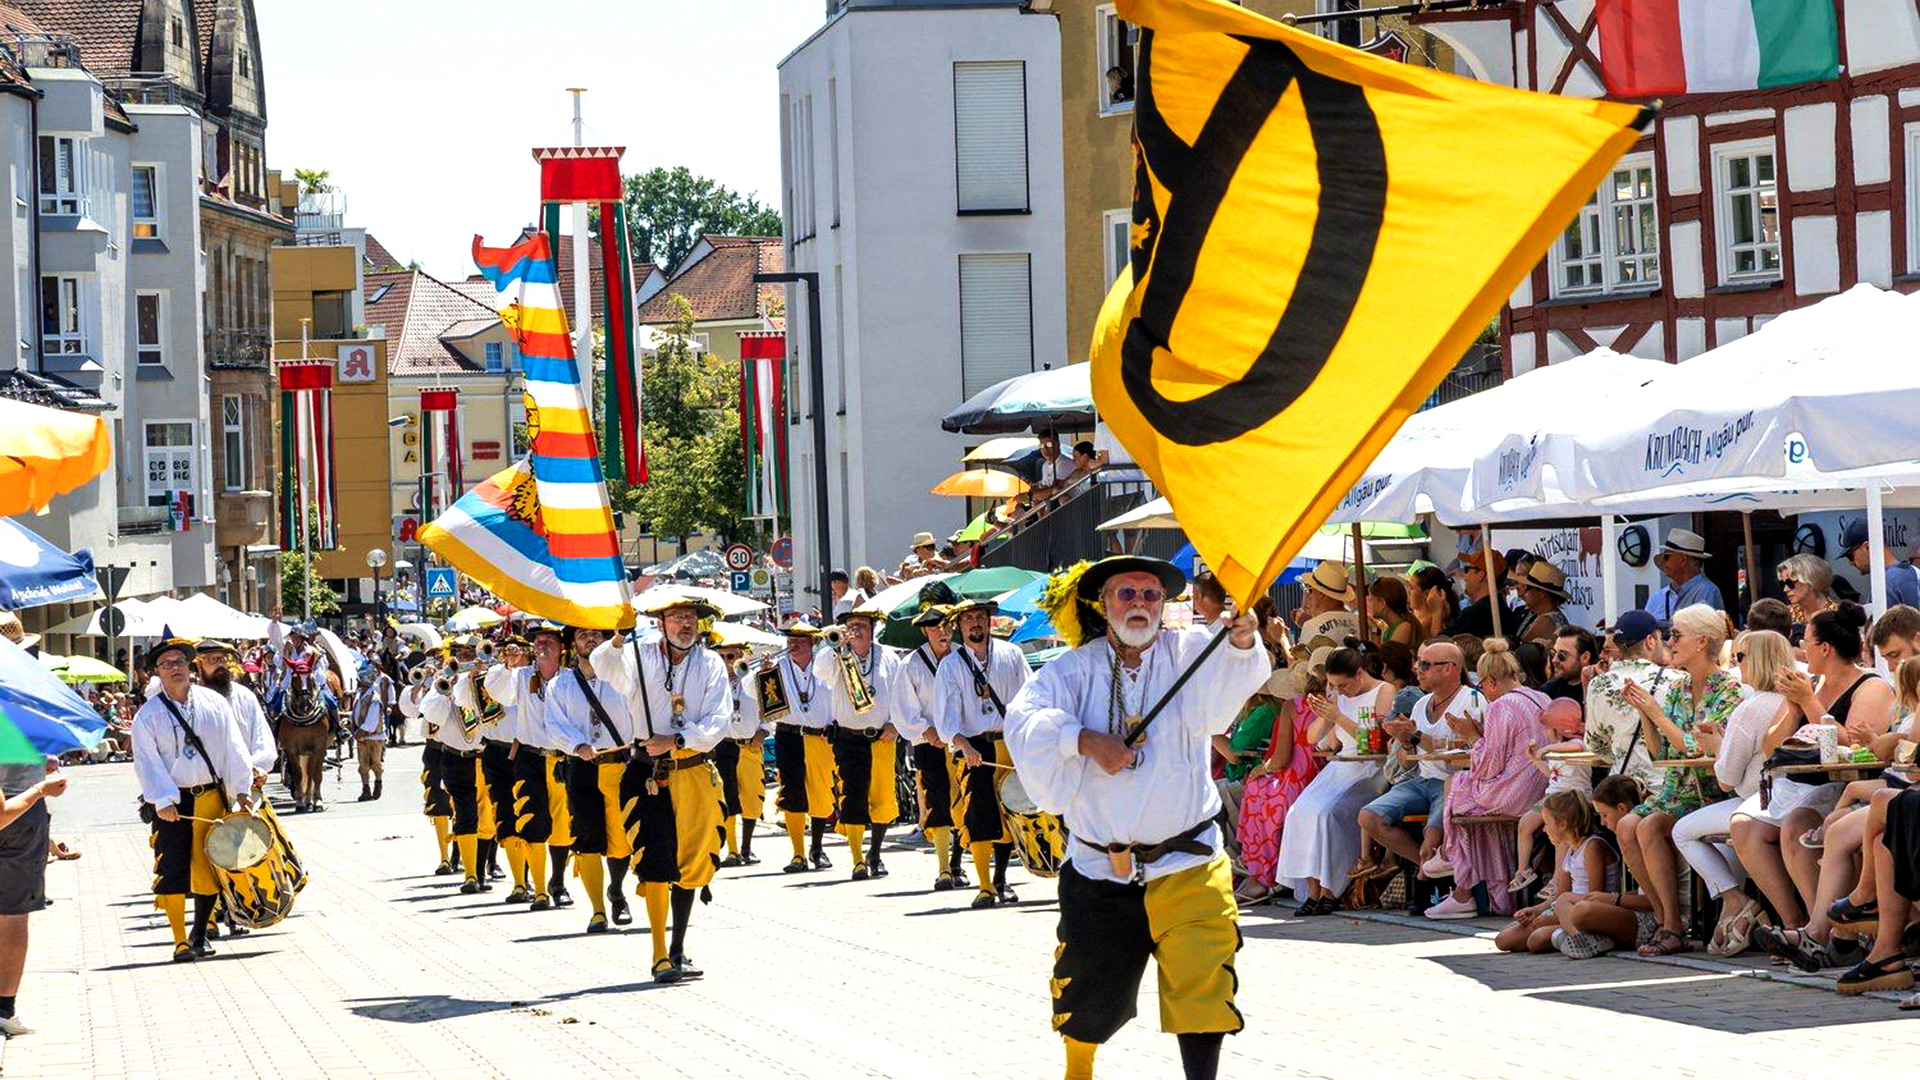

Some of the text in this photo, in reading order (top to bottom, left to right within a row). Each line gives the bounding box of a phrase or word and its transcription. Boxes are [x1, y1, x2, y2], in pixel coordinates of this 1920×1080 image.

[1644, 409, 1754, 471] KRUMBACH Allgäu pur.
[1343, 480, 1373, 509] Allgäu
[732, 552, 748, 564] 30
[734, 574, 746, 589] P
